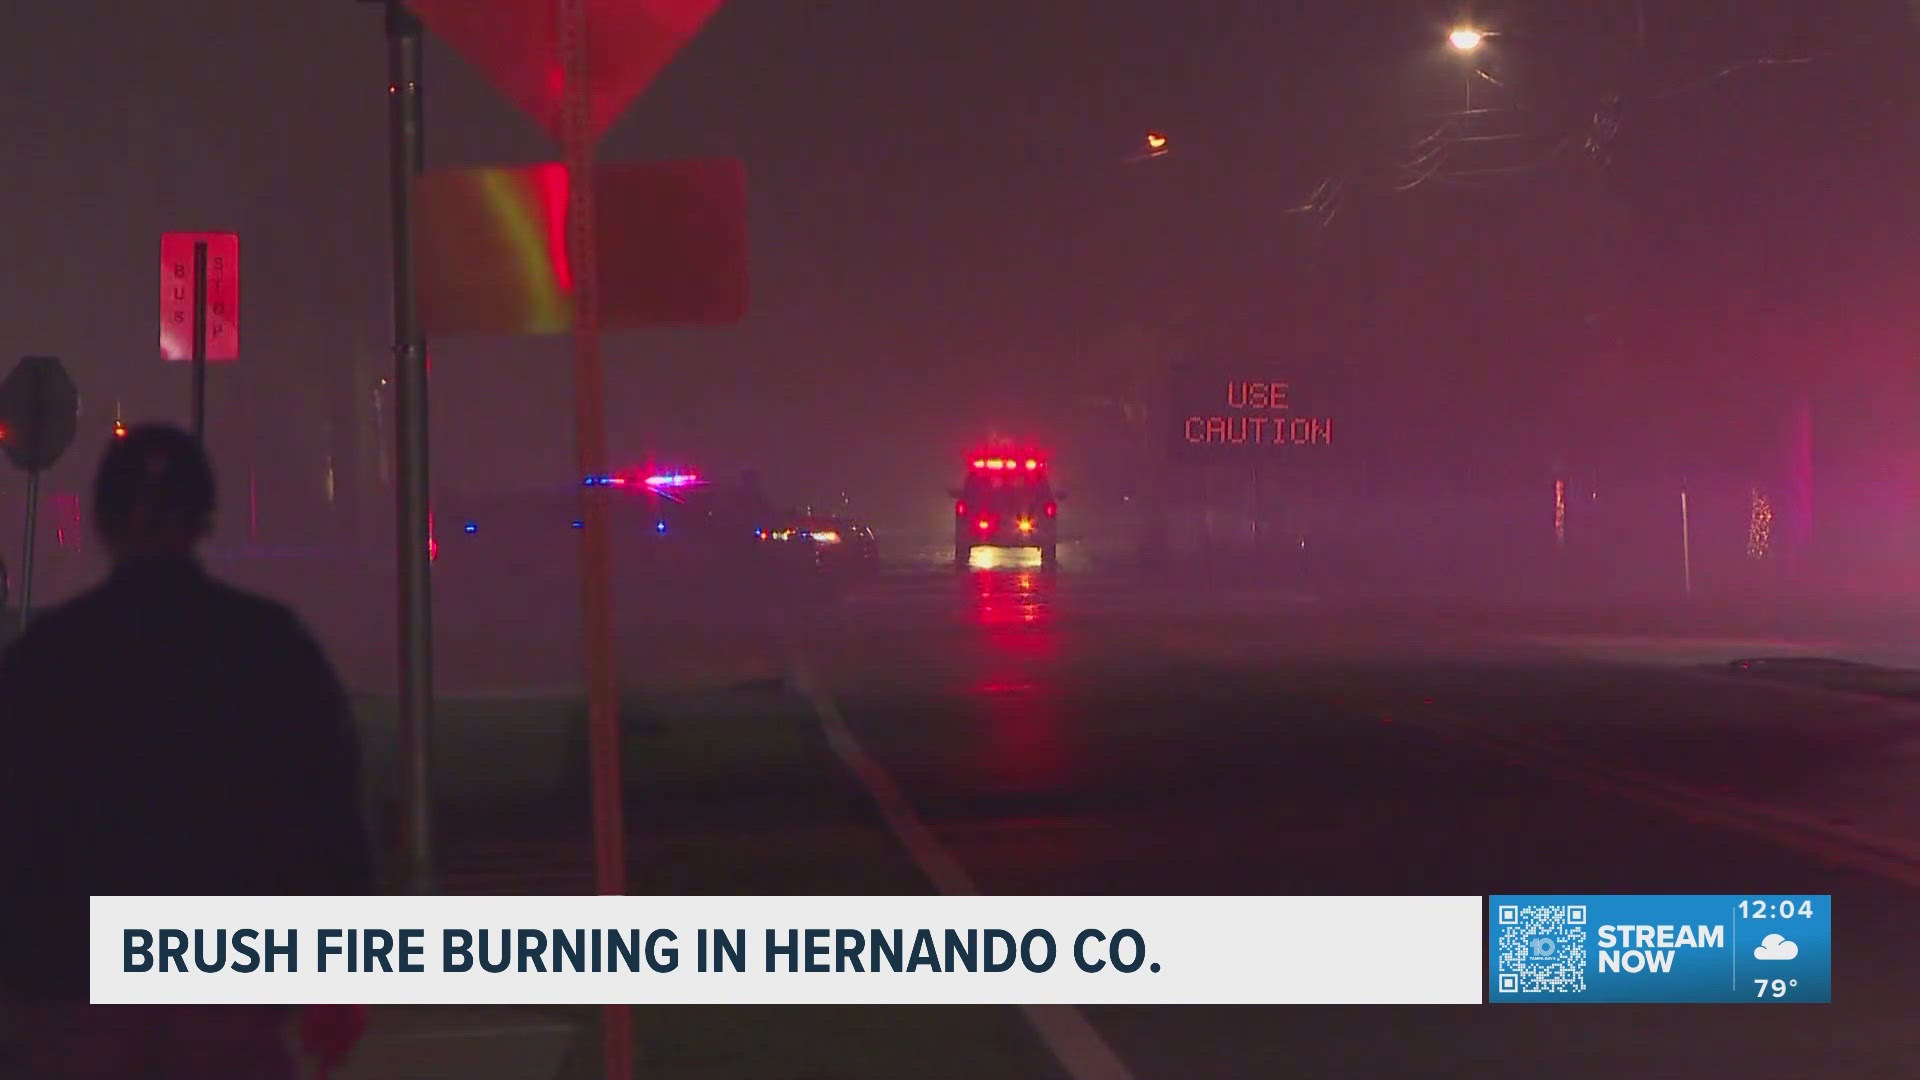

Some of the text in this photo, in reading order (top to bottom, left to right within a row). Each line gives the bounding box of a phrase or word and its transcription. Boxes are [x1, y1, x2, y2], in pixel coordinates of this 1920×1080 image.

[173, 263, 185, 323] BUS
[1228, 381, 1288, 408] USE
[1185, 417, 1331, 444] CAUTION
